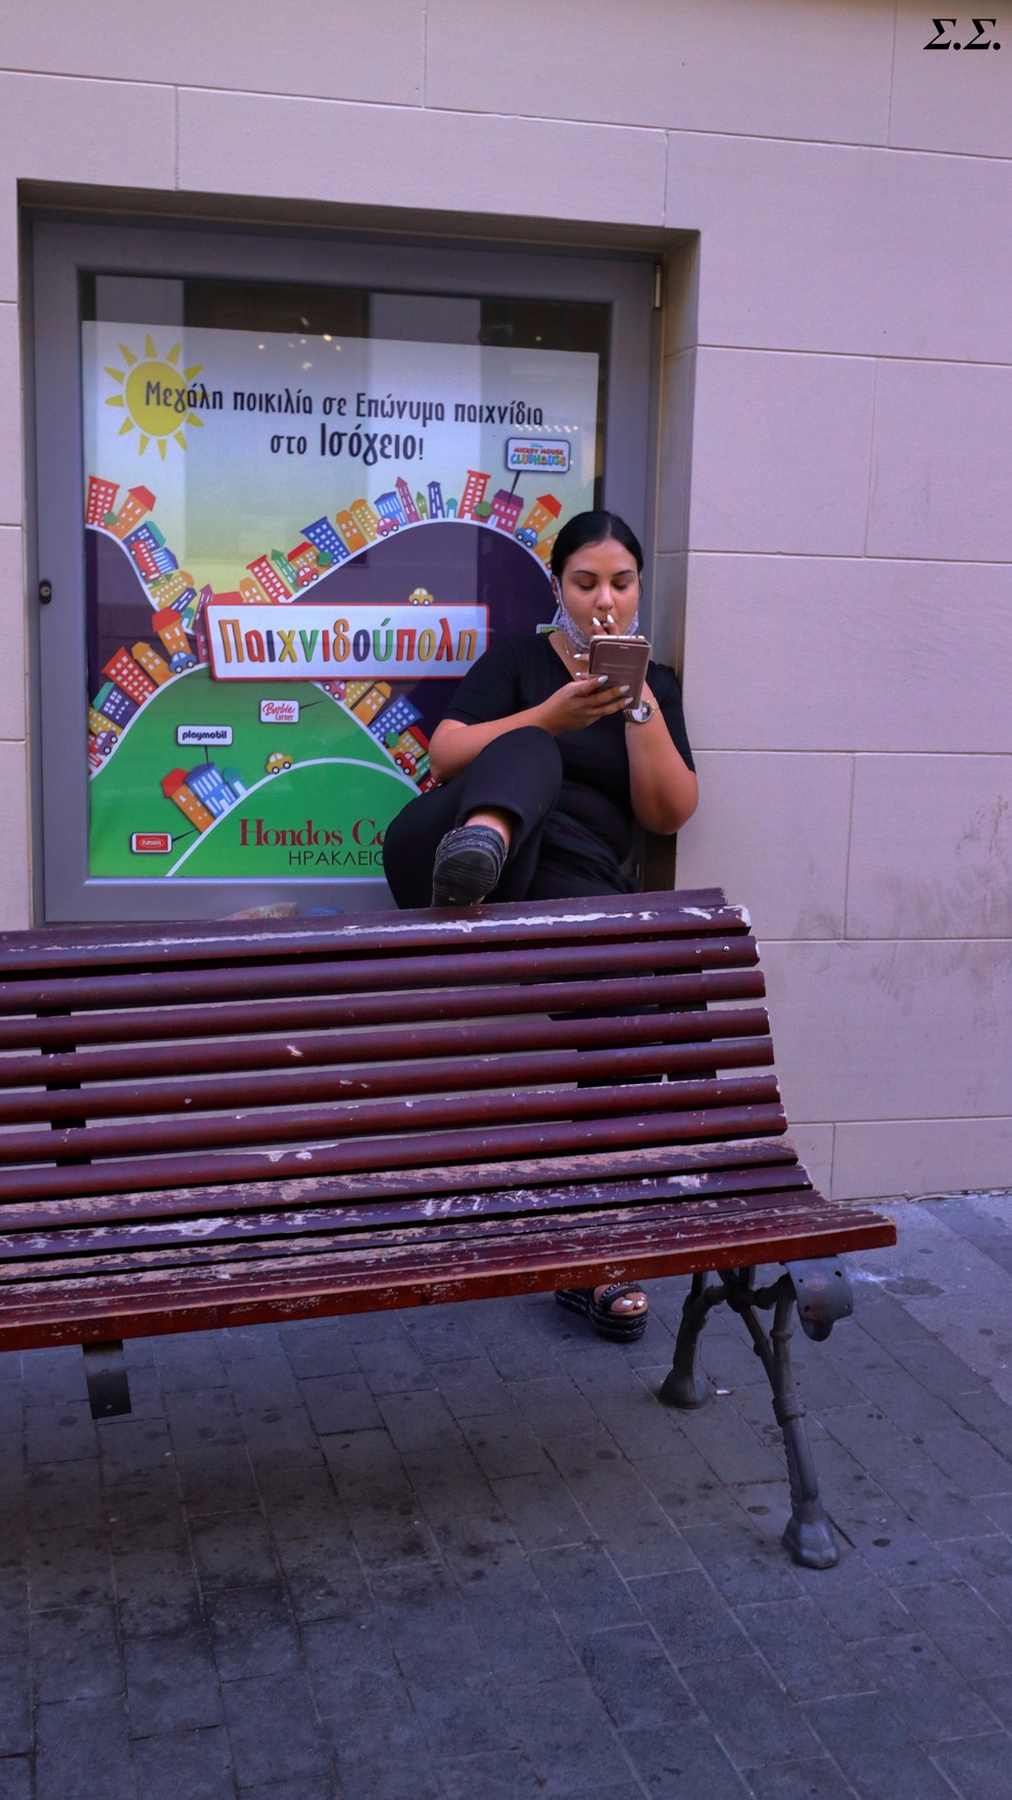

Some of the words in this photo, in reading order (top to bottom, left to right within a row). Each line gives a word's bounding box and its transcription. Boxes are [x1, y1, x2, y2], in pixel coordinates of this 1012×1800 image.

[145, 380, 224, 414] Μεγάλη
[233, 388, 313, 415] ποικιλία
[322, 396, 347, 416] σε
[355, 392, 445, 428] Επώνυμα
[454, 400, 544, 427] παιχνίδια
[270, 434, 307, 455] στο
[320, 422, 424, 466] Ισόγειο!
[510, 453, 566, 467] CLUBHOUSE
[218, 617, 478, 663] Παιχνιδούπολη
[262, 702, 296, 717] Barbie
[275, 713, 294, 721] Corner
[182, 730, 228, 741] playmobil
[239, 818, 343, 847] Hondos
